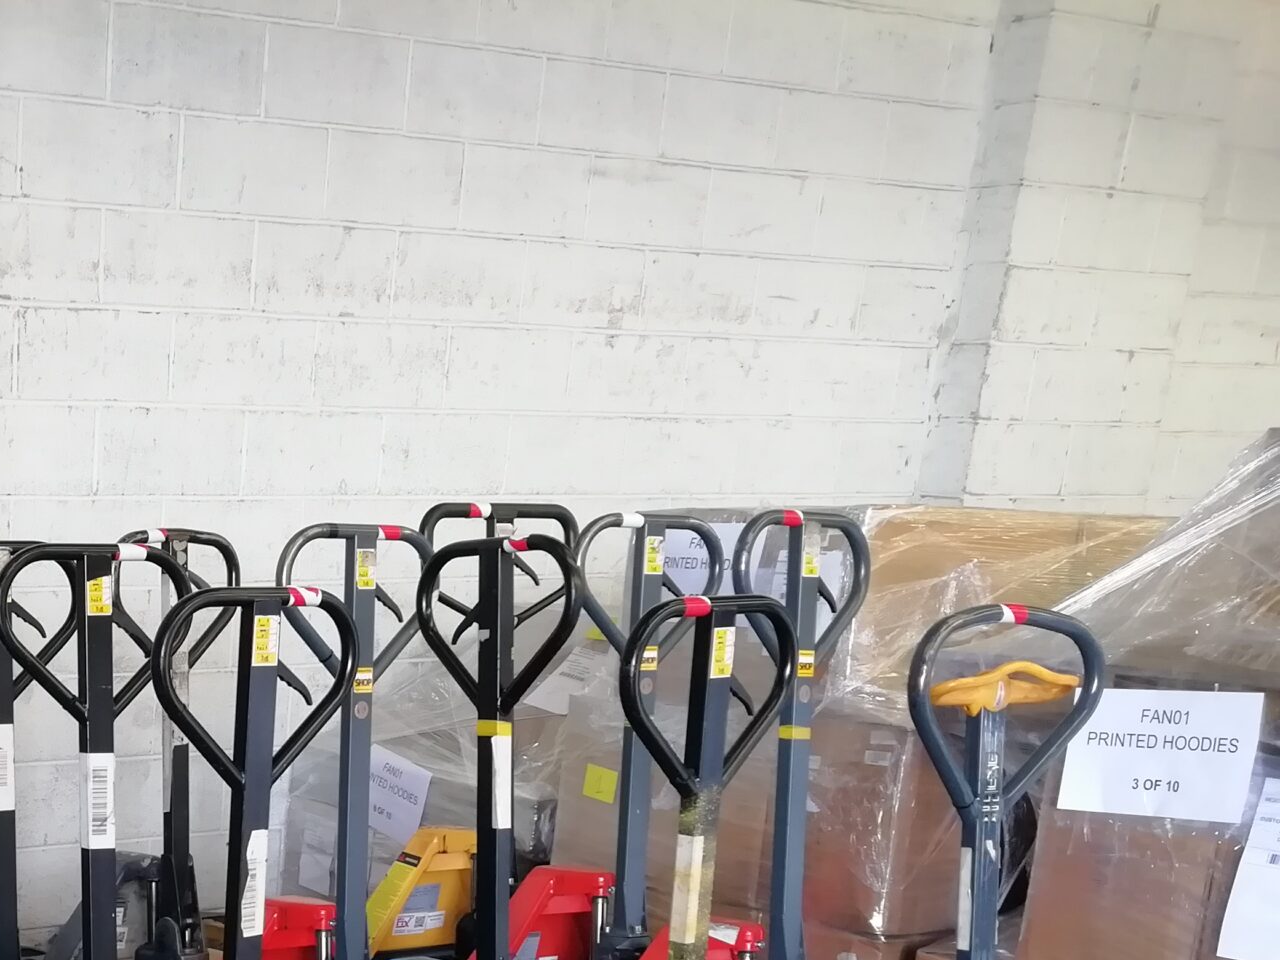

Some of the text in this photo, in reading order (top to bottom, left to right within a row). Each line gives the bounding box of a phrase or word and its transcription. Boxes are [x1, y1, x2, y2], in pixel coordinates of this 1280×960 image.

[663, 556, 699, 570] RINTED
[1140, 708, 1191, 725] FAN01
[1086, 731, 1240, 754] PRINTED HOODIES
[370, 772, 389, 789] NTED
[1131, 778, 1180, 793] 3 OF 10
